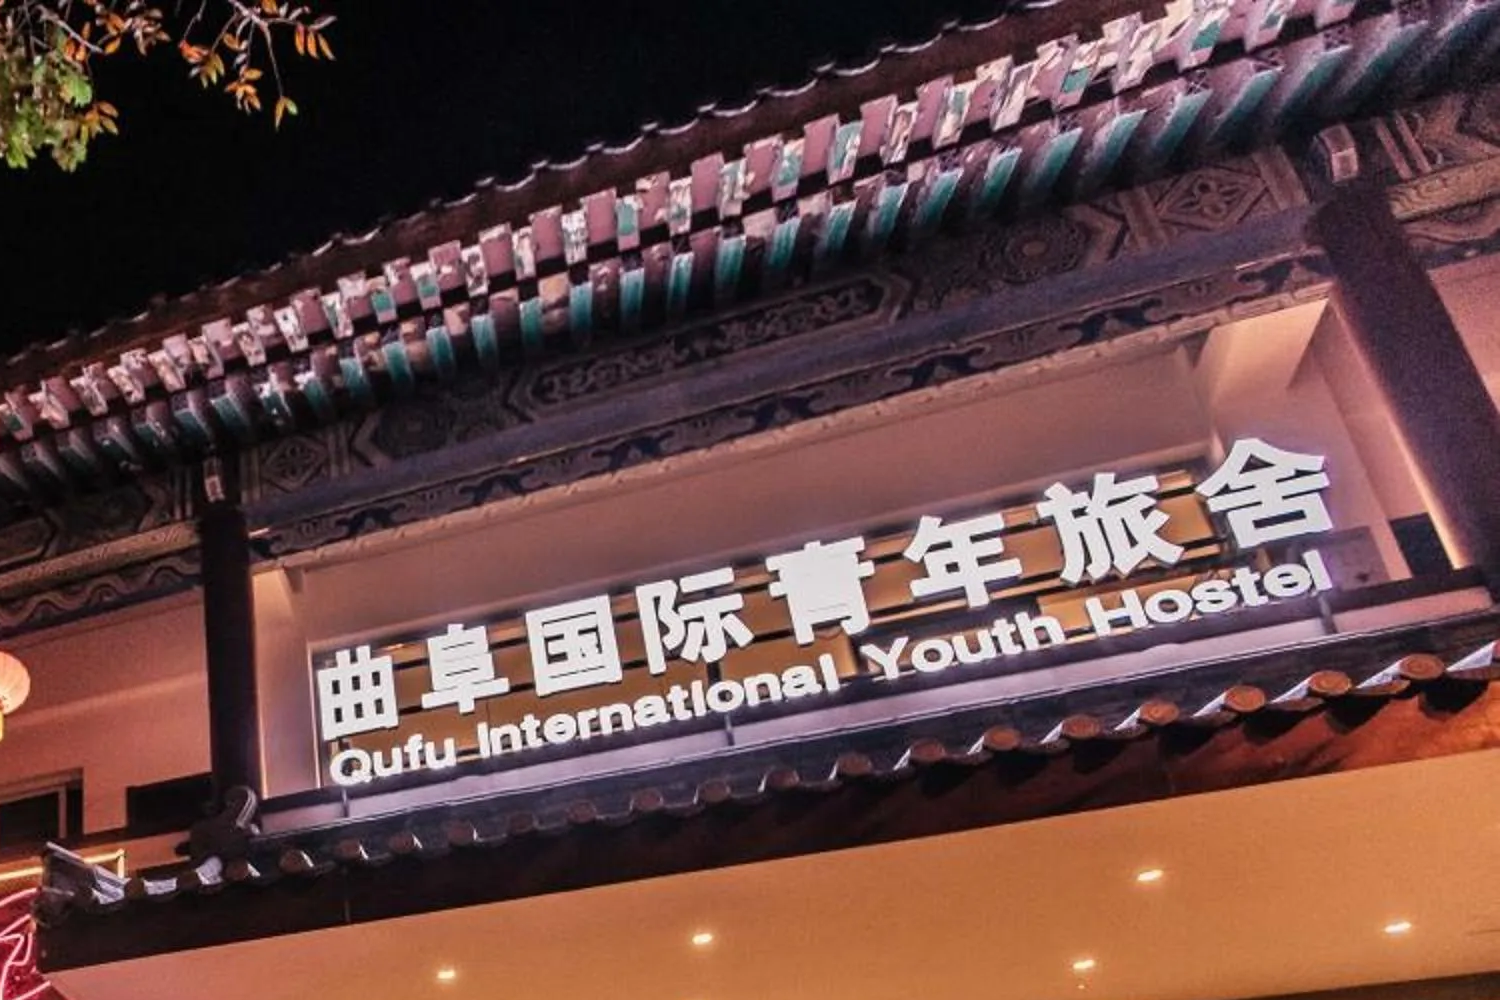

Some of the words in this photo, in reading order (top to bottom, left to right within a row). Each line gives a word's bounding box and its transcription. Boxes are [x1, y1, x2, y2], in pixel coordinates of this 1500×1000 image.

[316, 437, 1333, 740] 曲阜国际青年旅舍
[329, 735, 458, 786] Qufu
[477, 653, 841, 761] International
[861, 603, 1066, 684] Youth
[1084, 550, 1333, 639] Hostel
